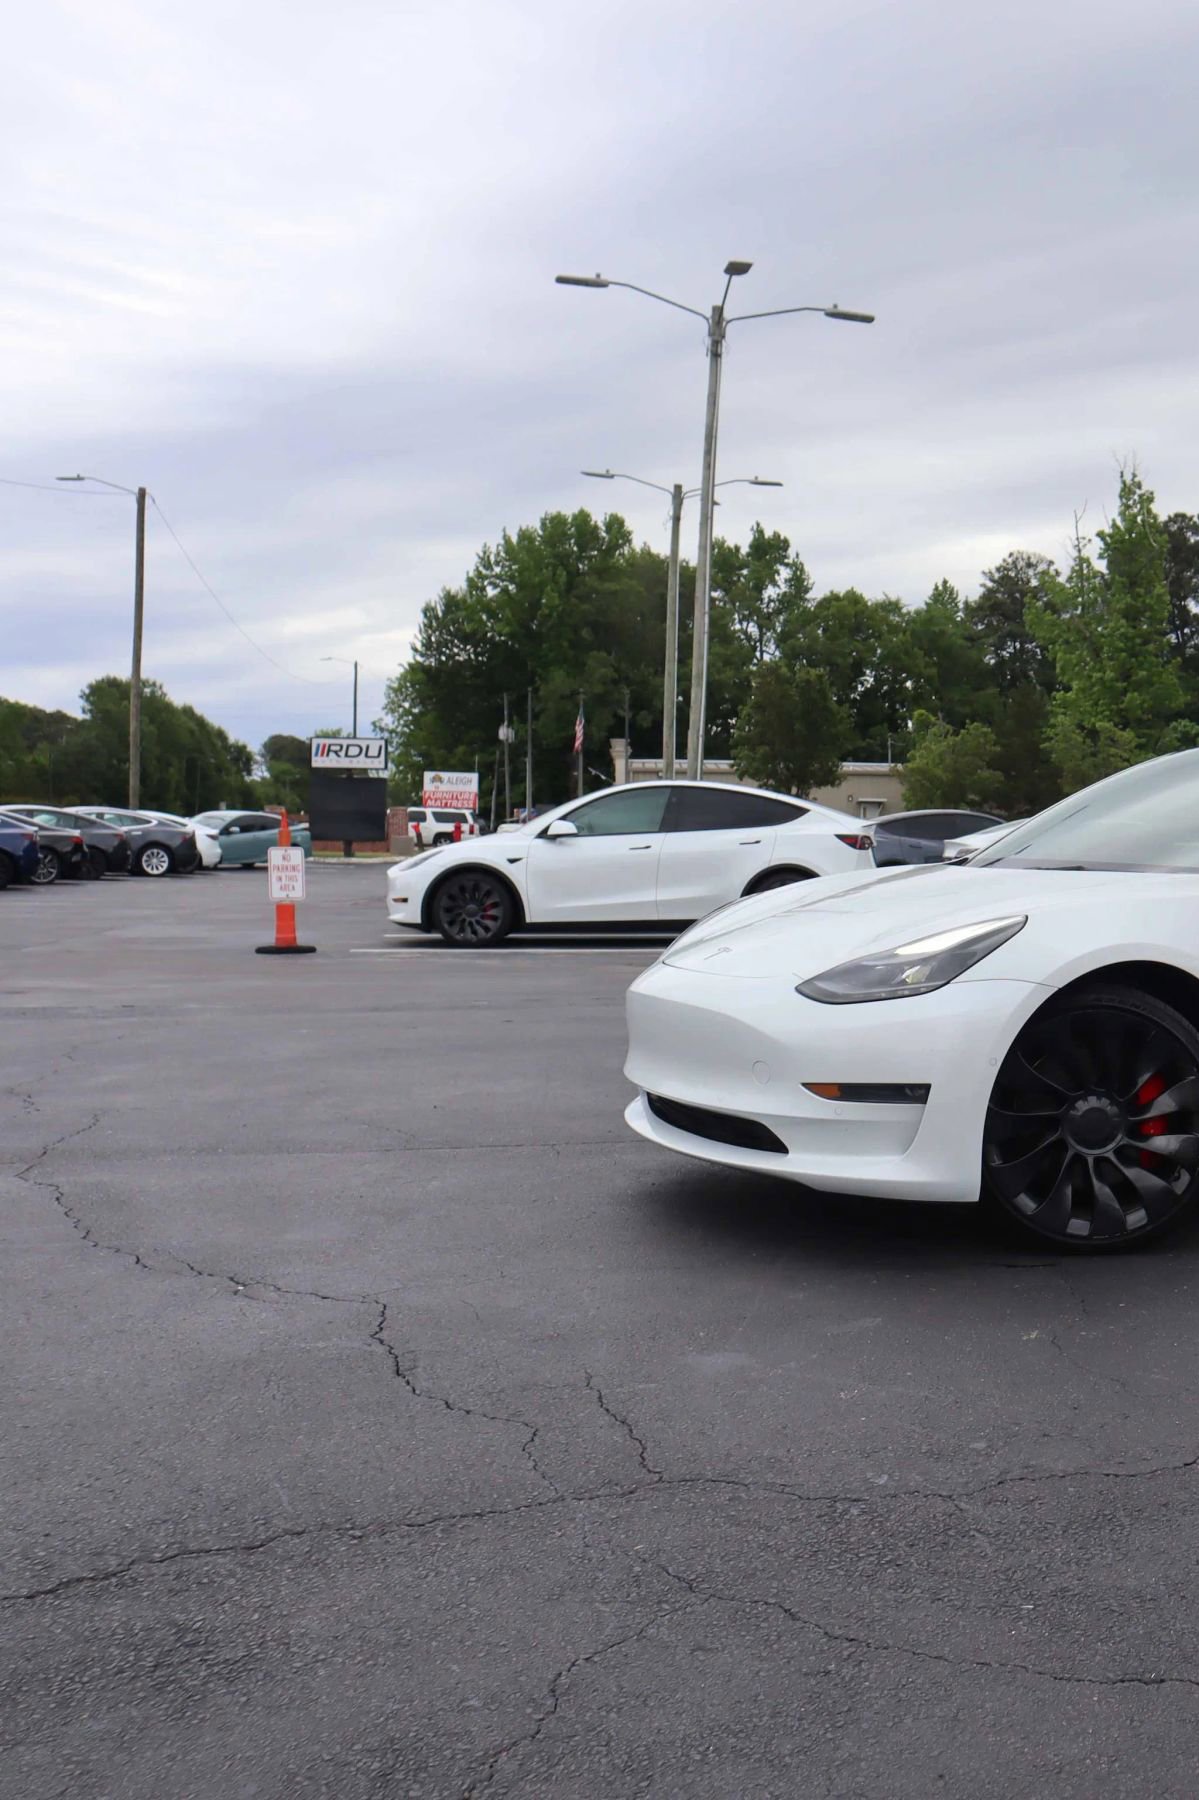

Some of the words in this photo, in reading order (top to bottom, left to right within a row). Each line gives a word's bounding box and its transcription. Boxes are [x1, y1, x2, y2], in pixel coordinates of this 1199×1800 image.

[326, 743, 383, 759] RDU
[424, 790, 475, 801] FURNITURE
[426, 799, 474, 808] MATTRESS
[281, 853, 291, 863] NO
[272, 863, 301, 873] PARKING
[285, 874, 298, 882] THIS
[280, 884, 296, 892] AREA
